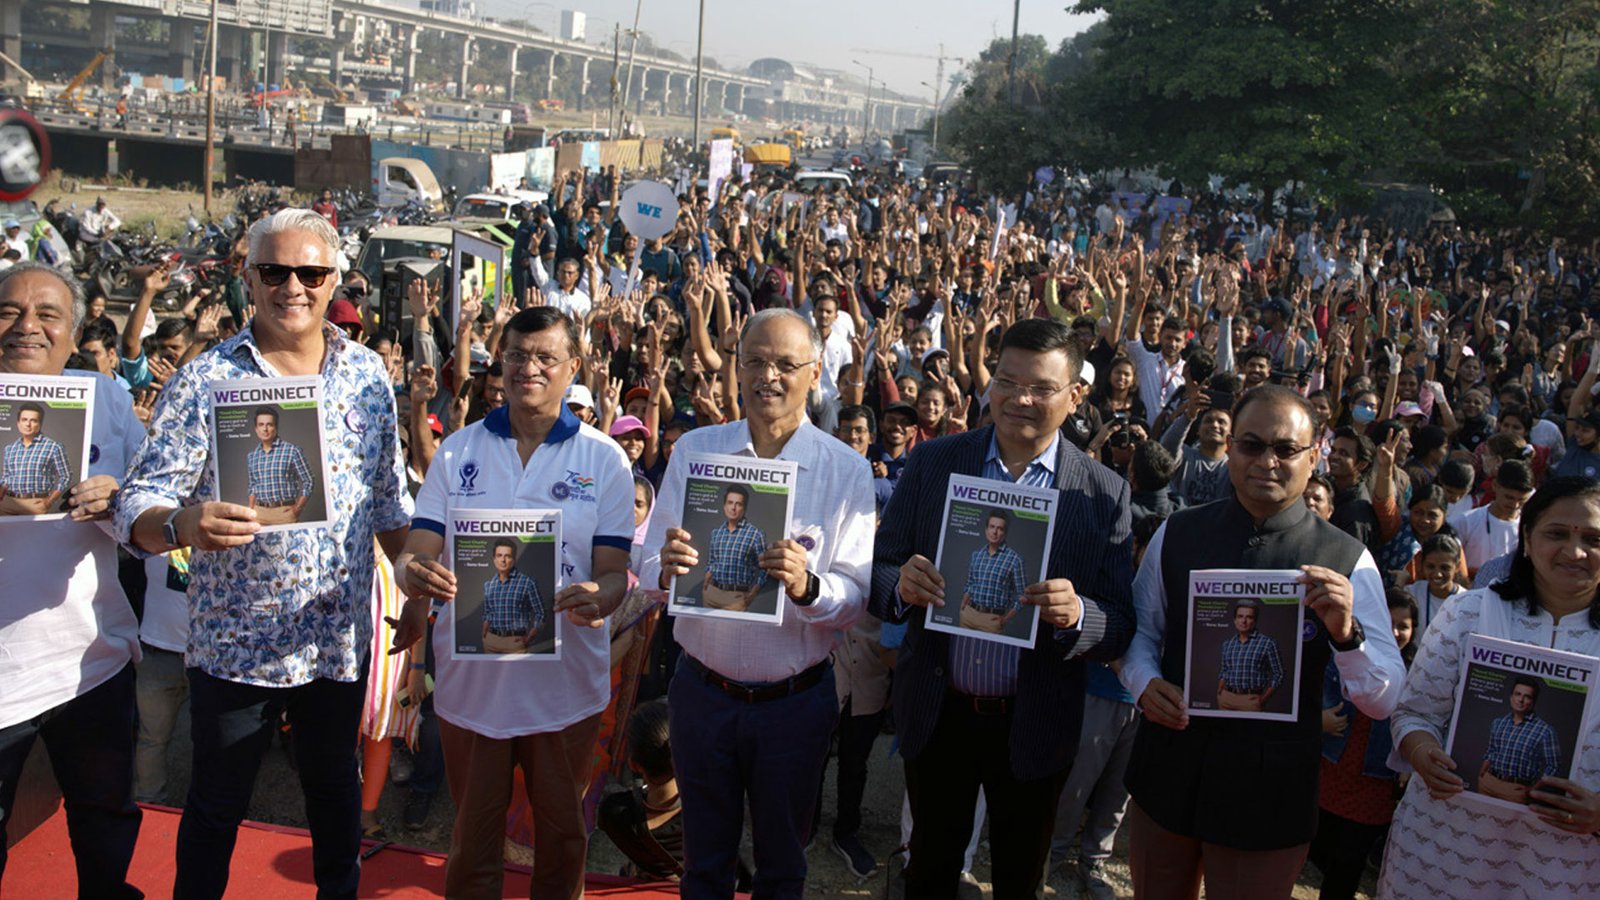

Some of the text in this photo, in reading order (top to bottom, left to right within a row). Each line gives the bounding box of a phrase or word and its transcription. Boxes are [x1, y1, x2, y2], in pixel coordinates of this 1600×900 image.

[637, 201, 662, 219] WE
[0, 384, 88, 399] ECONNECT
[214, 386, 316, 403] WECONNECT
[689, 462, 791, 484] WECONNECT
[953, 485, 1053, 511] WECONNECT
[454, 520, 556, 533] WECONNECT
[1195, 582, 1300, 595] WECONNECT
[1473, 646, 1592, 682] WECONNECT
